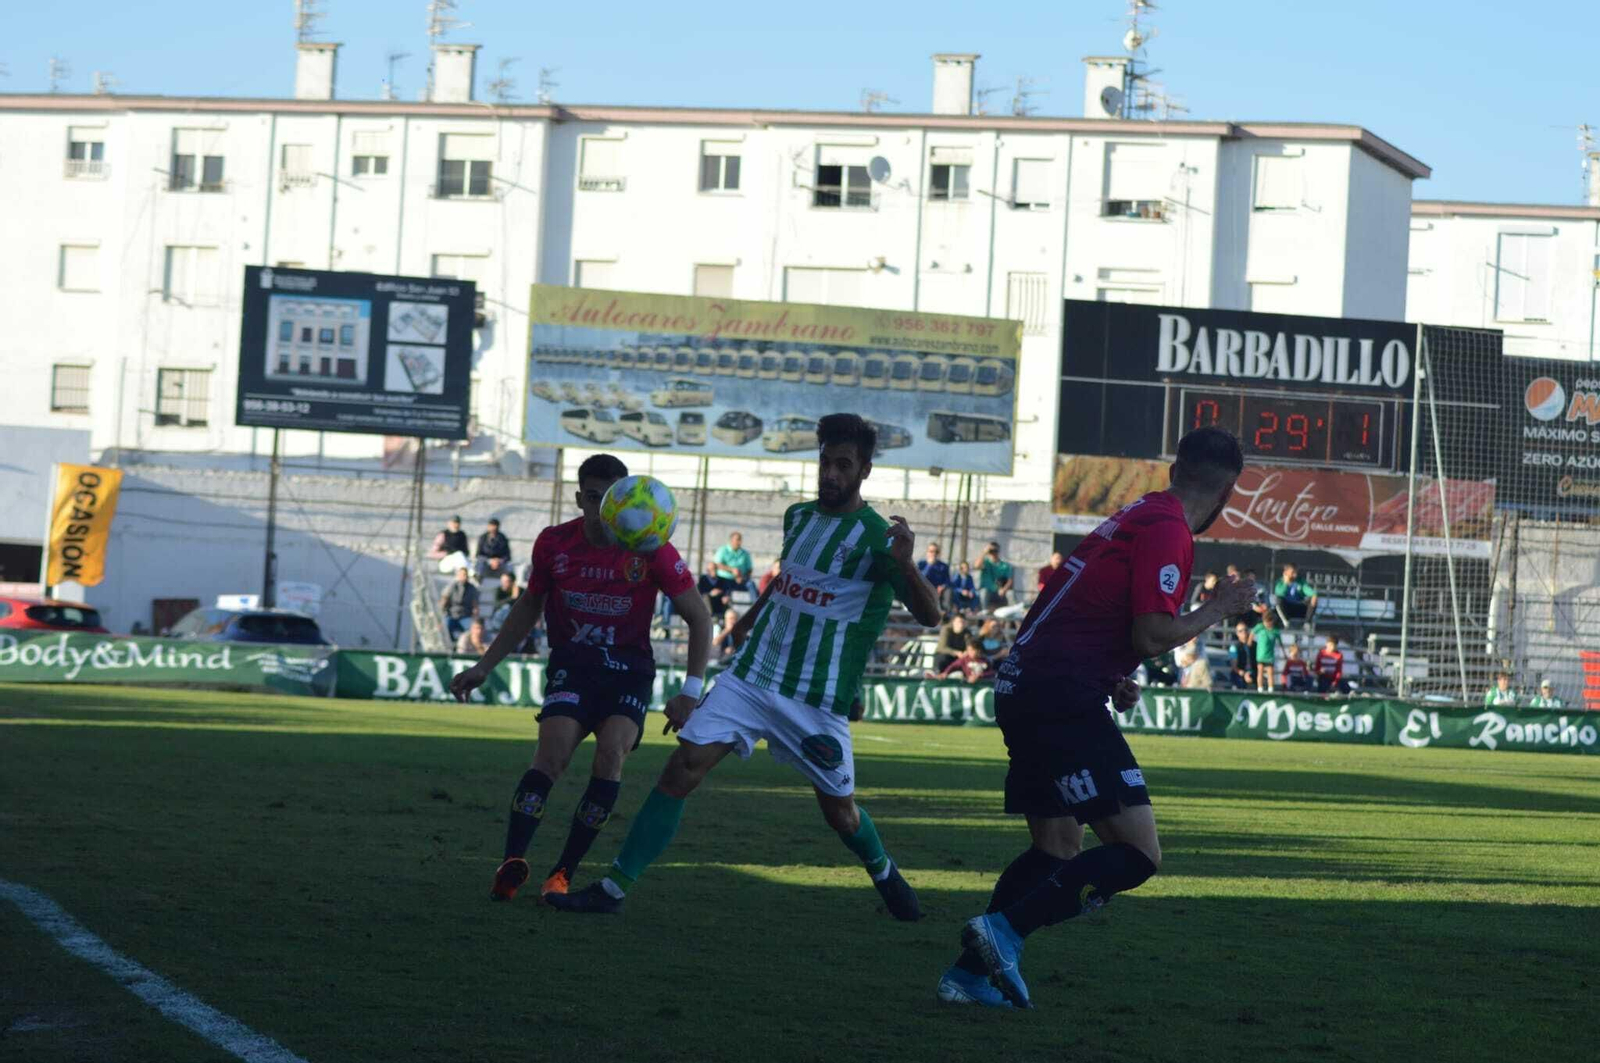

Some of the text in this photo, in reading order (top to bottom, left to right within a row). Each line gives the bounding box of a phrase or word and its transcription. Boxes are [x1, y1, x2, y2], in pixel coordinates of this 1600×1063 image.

[550, 295, 856, 342] Autocares Zambrano
[893, 317, 925, 331] 956
[1156, 313, 1411, 389] BARBADILLO
[1361, 412, 1369, 446] 1
[1522, 453, 1563, 467] ZERO
[771, 574, 837, 608] olear
[1236, 699, 1598, 750] Mesón El Rancho
